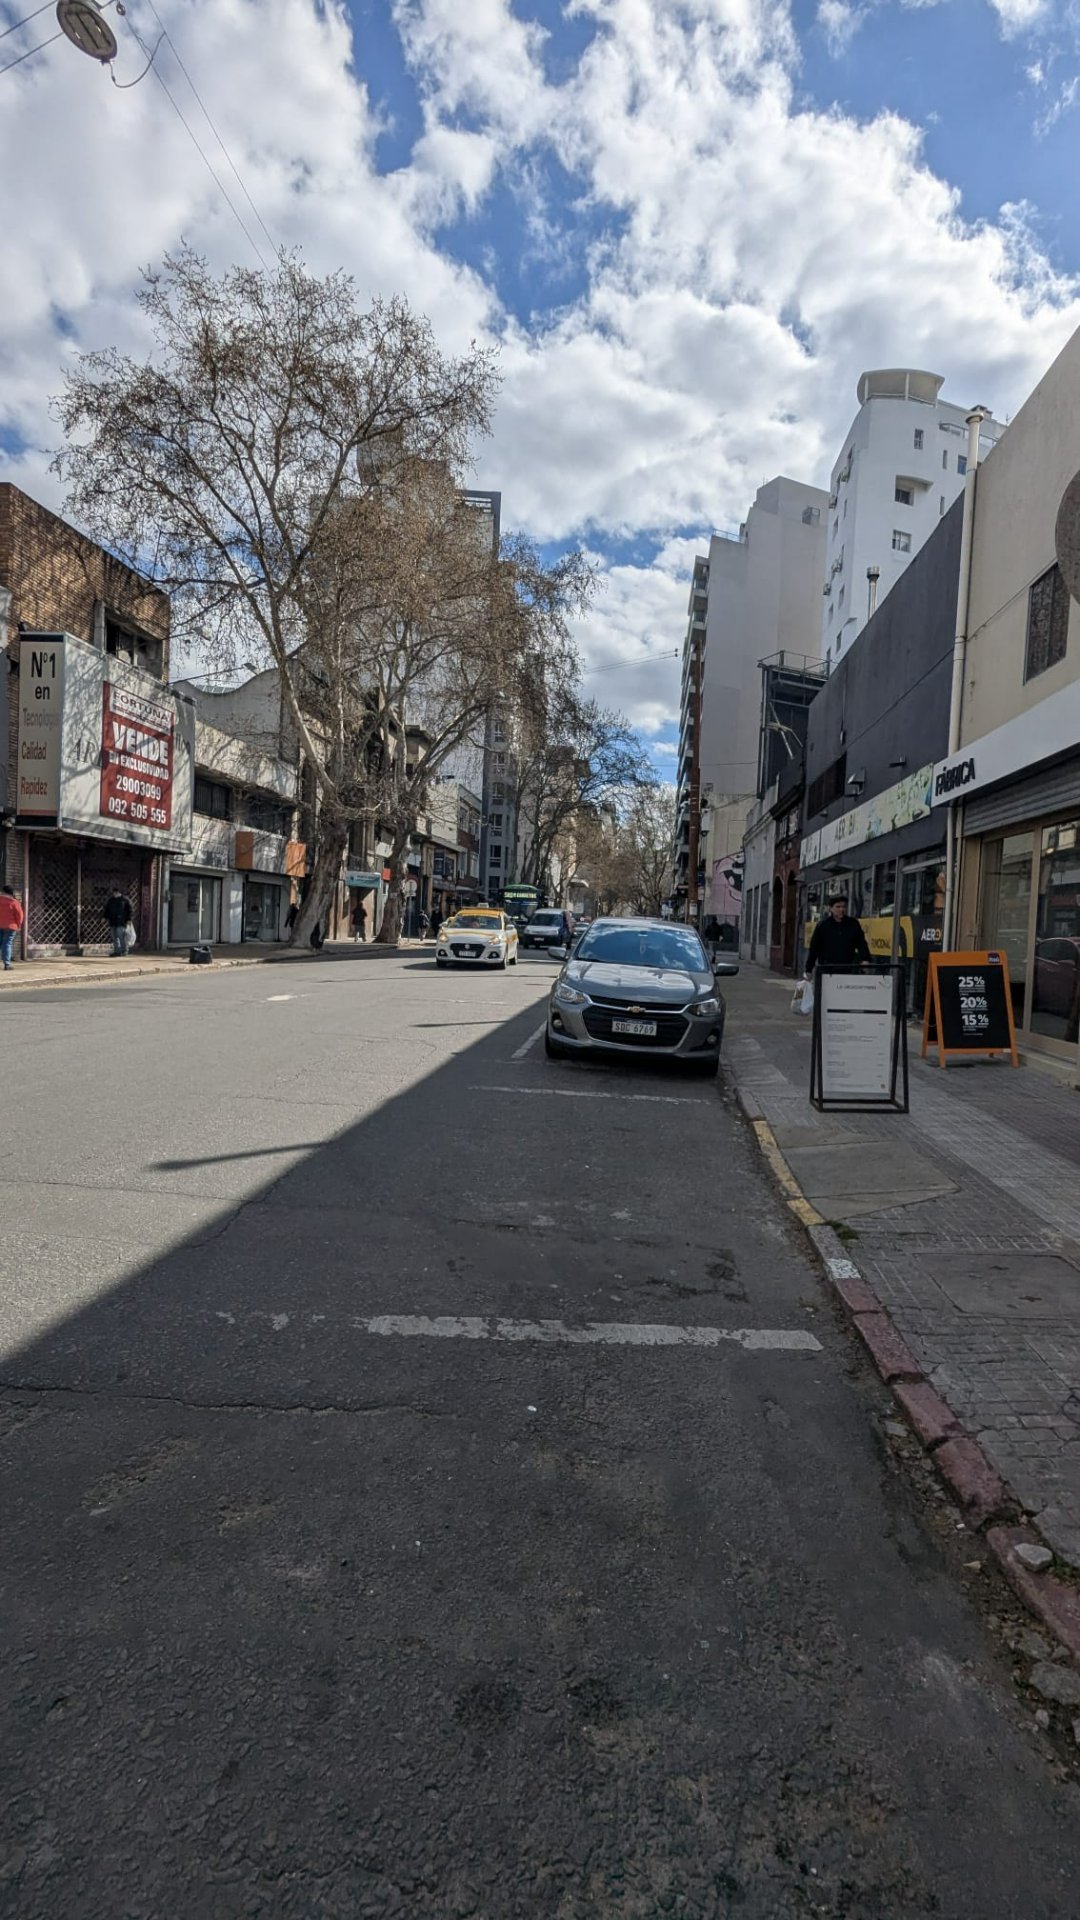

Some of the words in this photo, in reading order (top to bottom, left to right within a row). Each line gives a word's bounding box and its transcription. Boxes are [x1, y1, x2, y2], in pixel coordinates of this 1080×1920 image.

[35, 686, 50, 700] en
[113, 692, 170, 722] FORTUNA
[21, 741, 47, 760] Calidad
[112, 721, 169, 766] VENDE
[108, 751, 119, 765] EN
[120, 754, 169, 781] EXCLUSIVIDAD
[935, 757, 976, 797] FÁBRICA
[21, 777, 48, 800] Rapidez
[116, 774, 161, 801] 29003099
[108, 796, 127, 815] 092
[130, 803, 148, 820] 505
[150, 807, 167, 824] 555
[958, 975, 986, 988] 25%
[960, 996, 988, 1009] 20%
